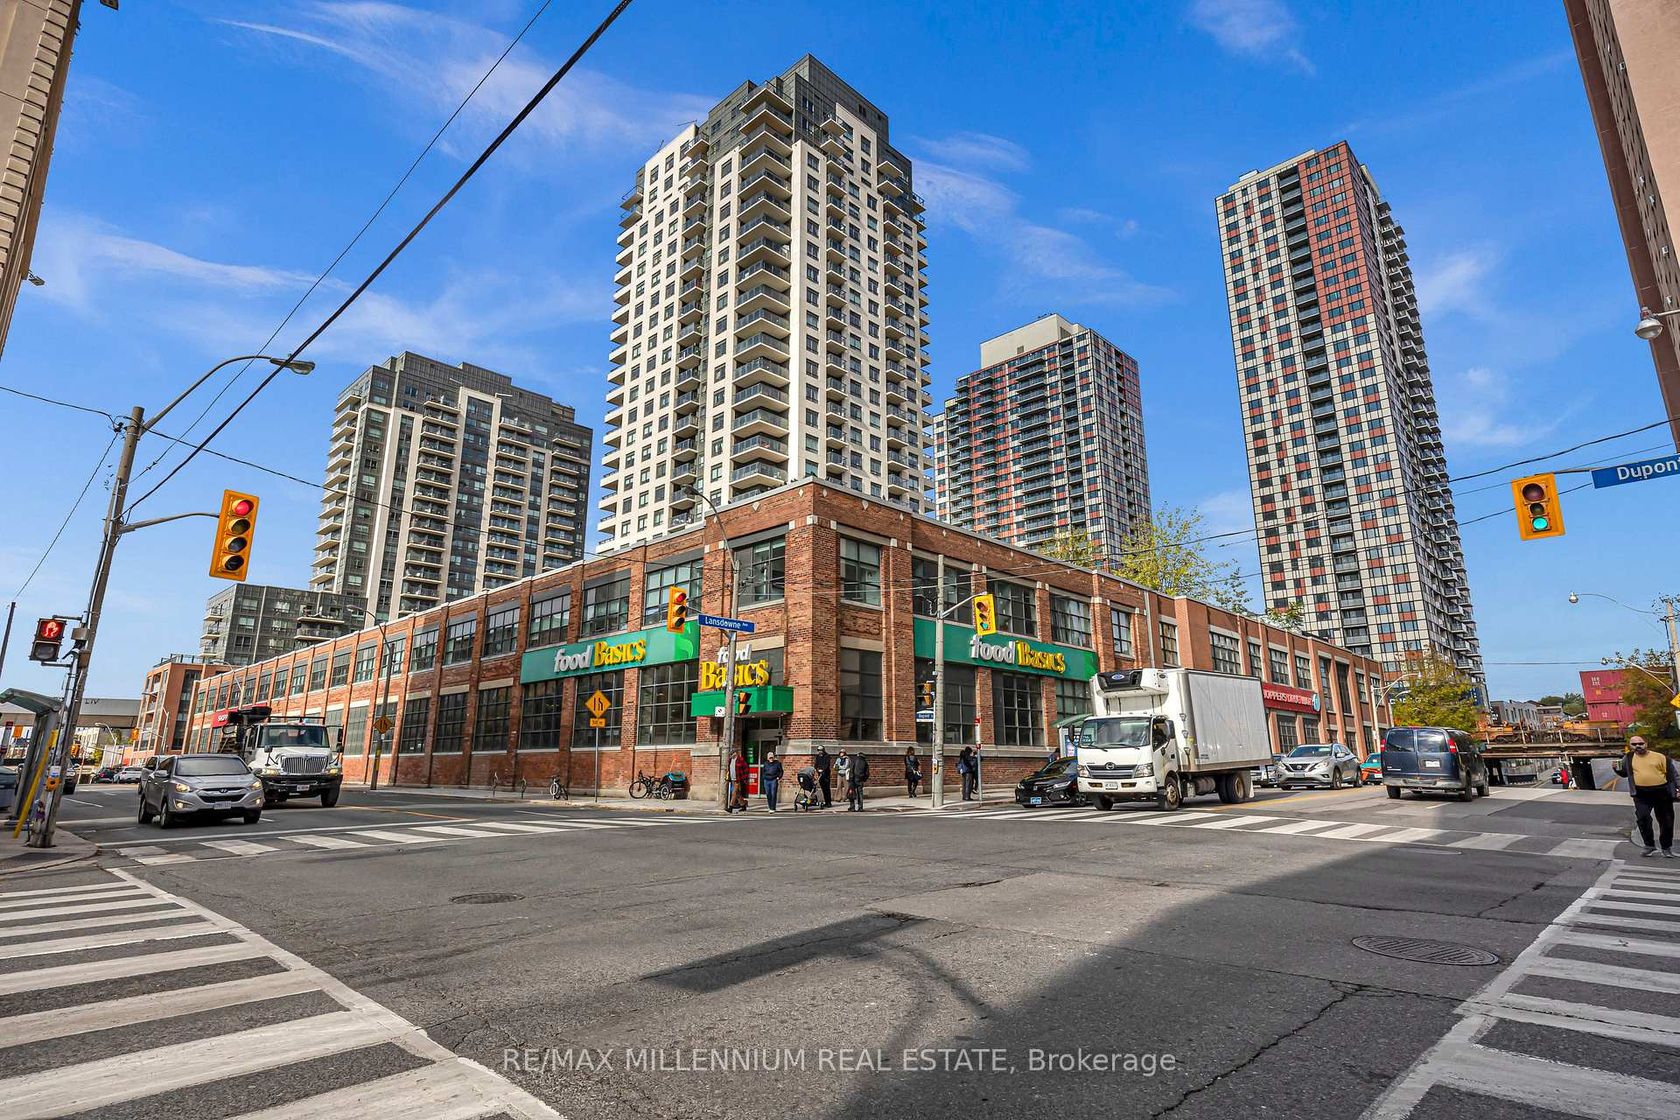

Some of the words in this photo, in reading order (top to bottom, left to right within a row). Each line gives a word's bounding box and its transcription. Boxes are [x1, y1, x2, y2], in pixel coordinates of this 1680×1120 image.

[705, 617, 741, 629] Lansdowne
[554, 644, 593, 673] food
[593, 639, 646, 667] Basics
[970, 633, 1015, 664] food
[1016, 640, 1065, 673] Basics
[701, 659, 769, 689] Baics
